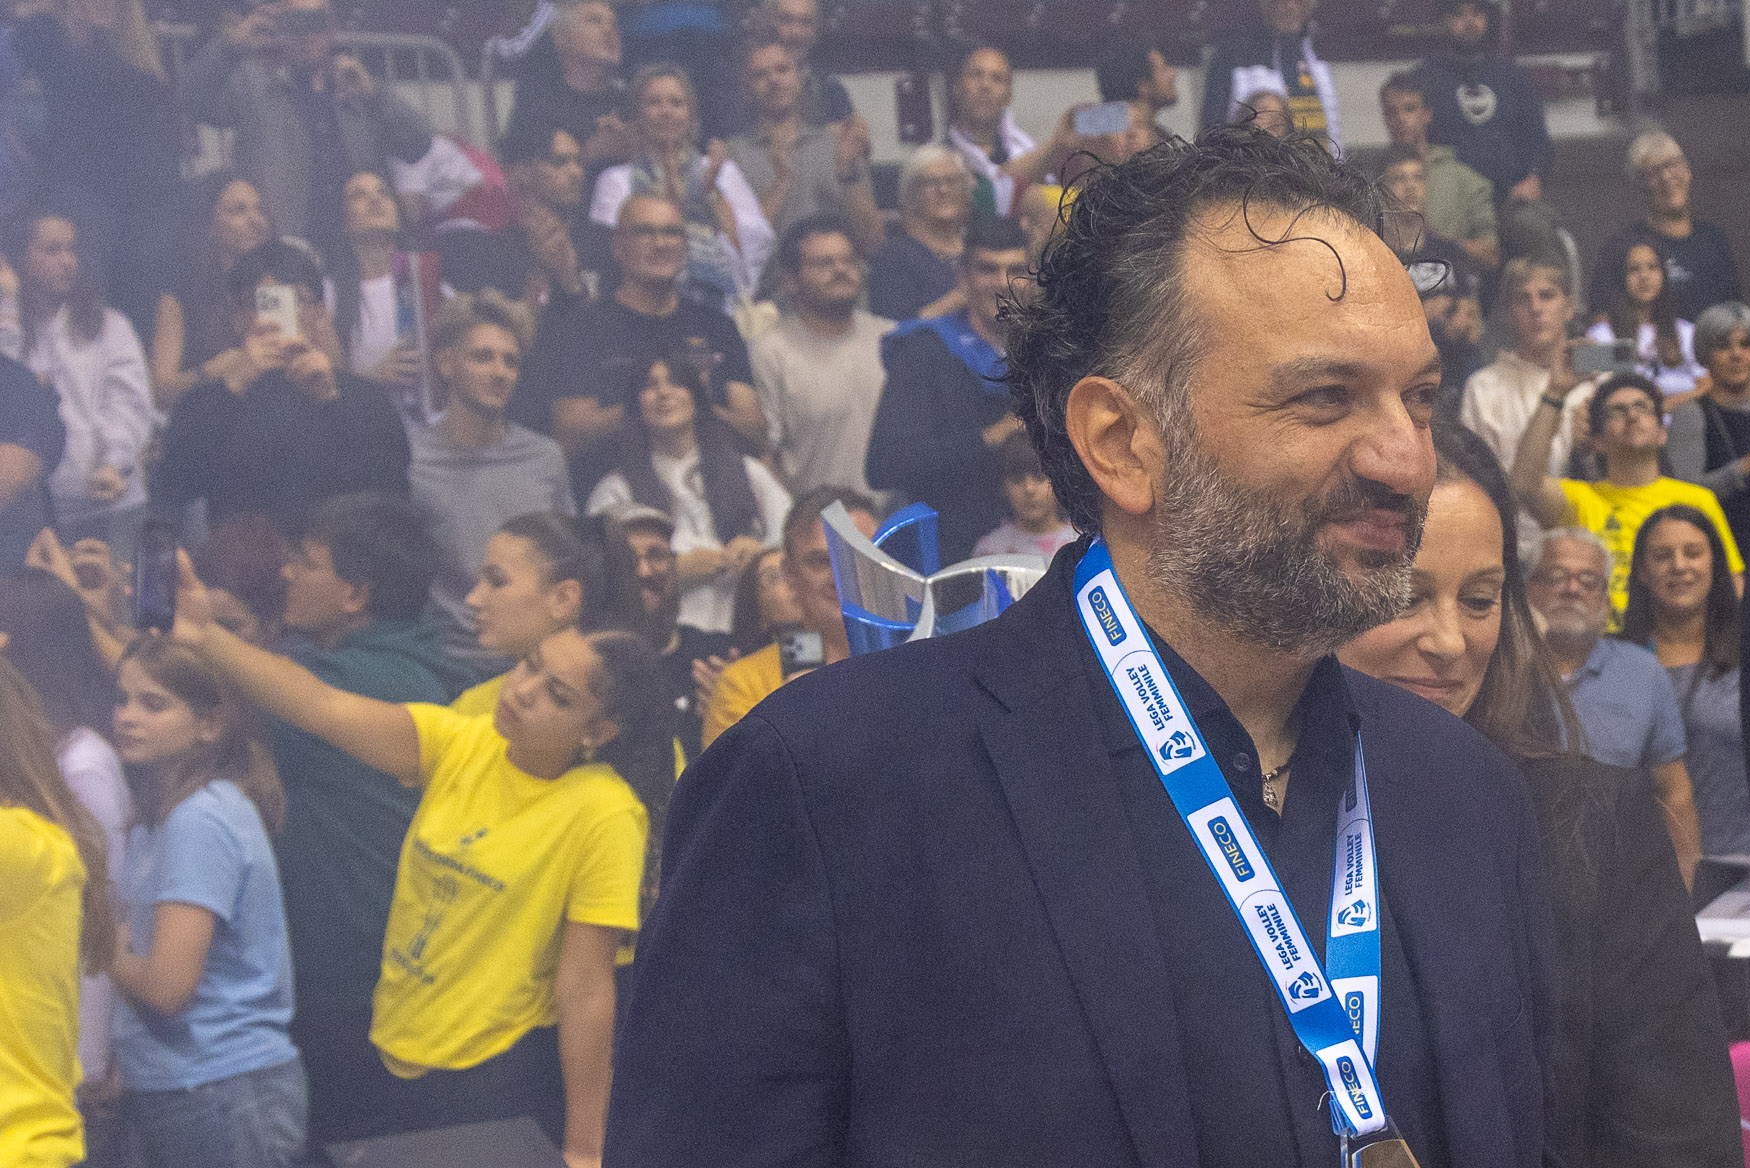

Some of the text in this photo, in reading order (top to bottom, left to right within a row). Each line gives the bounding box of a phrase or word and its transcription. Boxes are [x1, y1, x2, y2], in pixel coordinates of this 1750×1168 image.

[1092, 591, 1123, 641] FINECO
[1125, 667, 1166, 732] LEGA VOLLEY
[1137, 663, 1174, 722] FEMMINILE
[1213, 822, 1250, 877] FINECO
[1345, 834, 1355, 896] LEGA VOLLEY
[1354, 832, 1363, 889] FEMMINILE
[1254, 904, 1294, 971] LEGA VOLLEY
[1266, 903, 1302, 962] FEMMINILE
[1348, 996, 1361, 1035] ECO
[1341, 1061, 1369, 1115] FINECO
